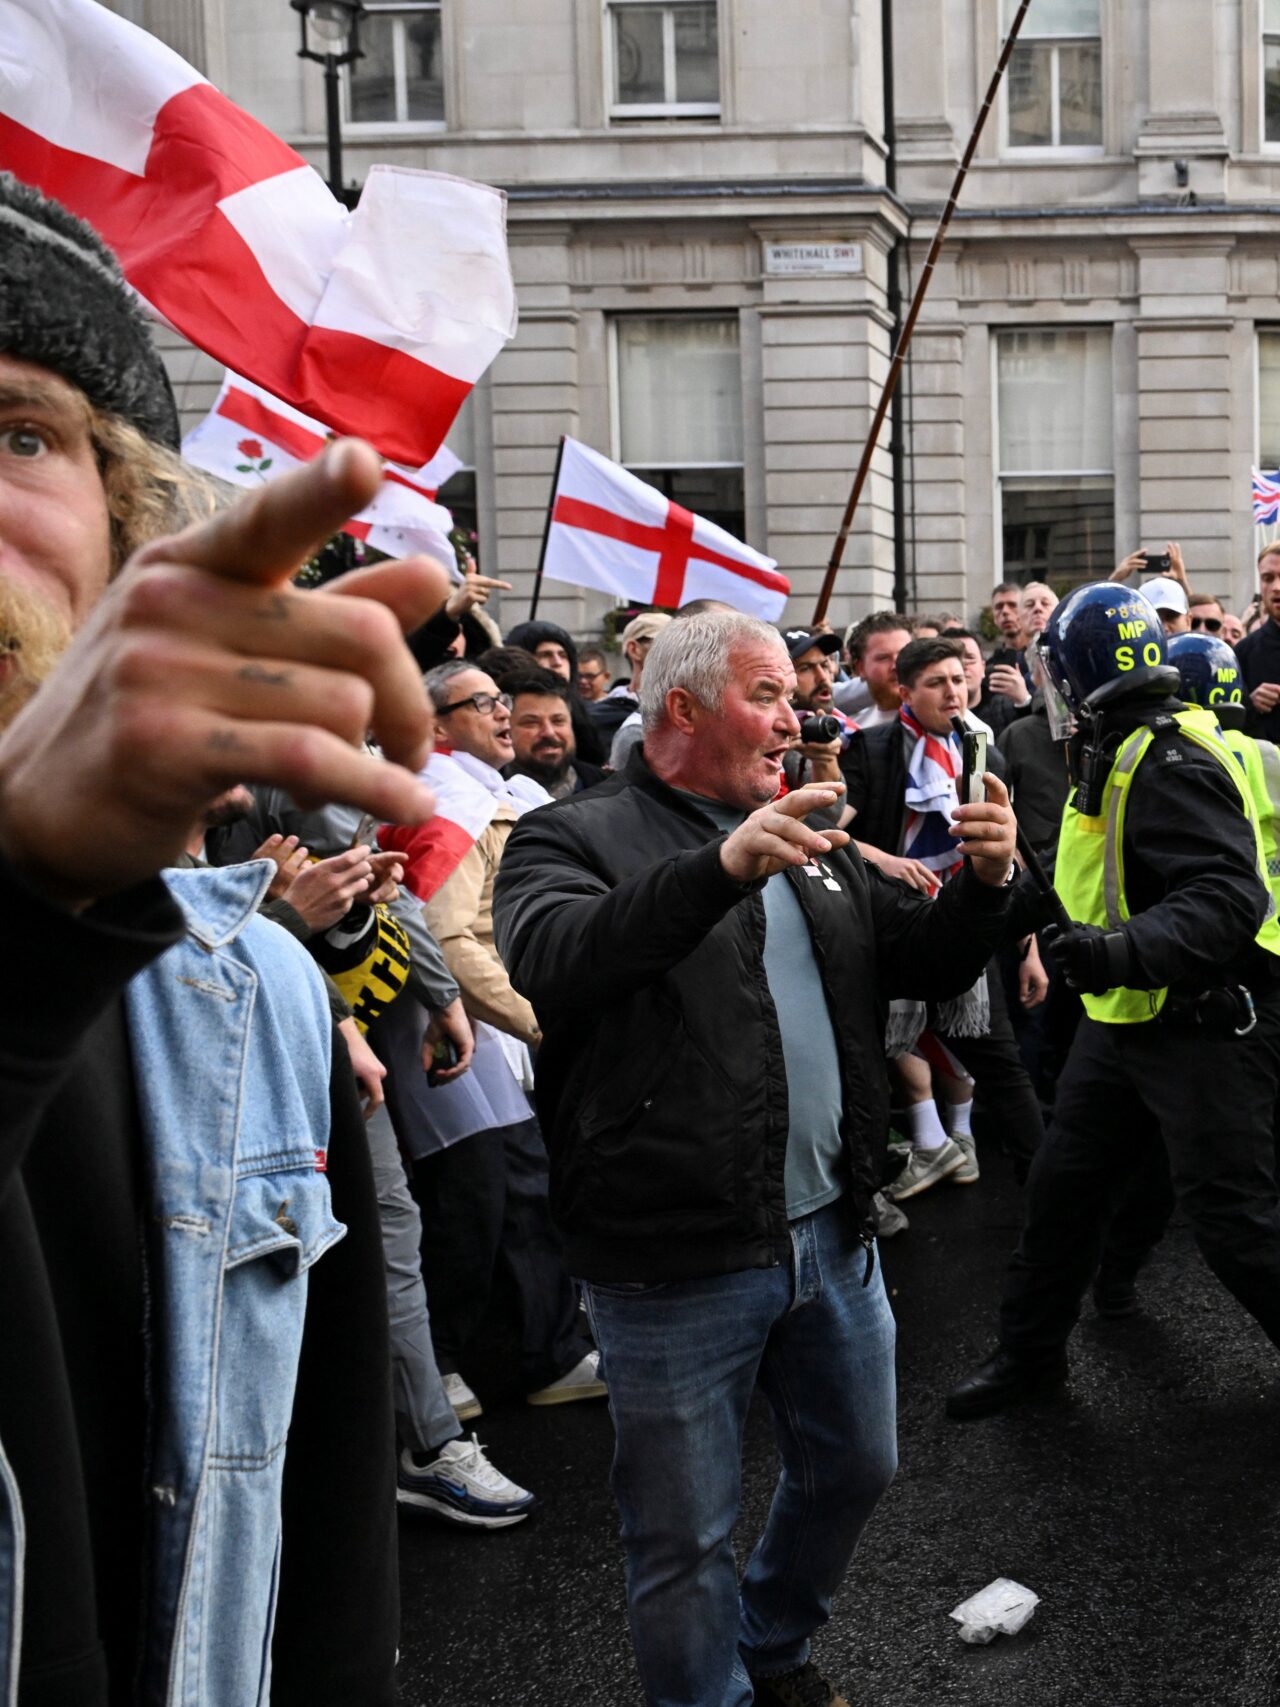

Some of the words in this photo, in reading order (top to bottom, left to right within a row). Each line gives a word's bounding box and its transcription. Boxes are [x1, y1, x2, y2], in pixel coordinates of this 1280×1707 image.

[771, 247, 830, 259] WHITEHALL
[833, 247, 855, 258] SW1
[1117, 620, 1146, 640] MP
[1217, 668, 1237, 683] MP
